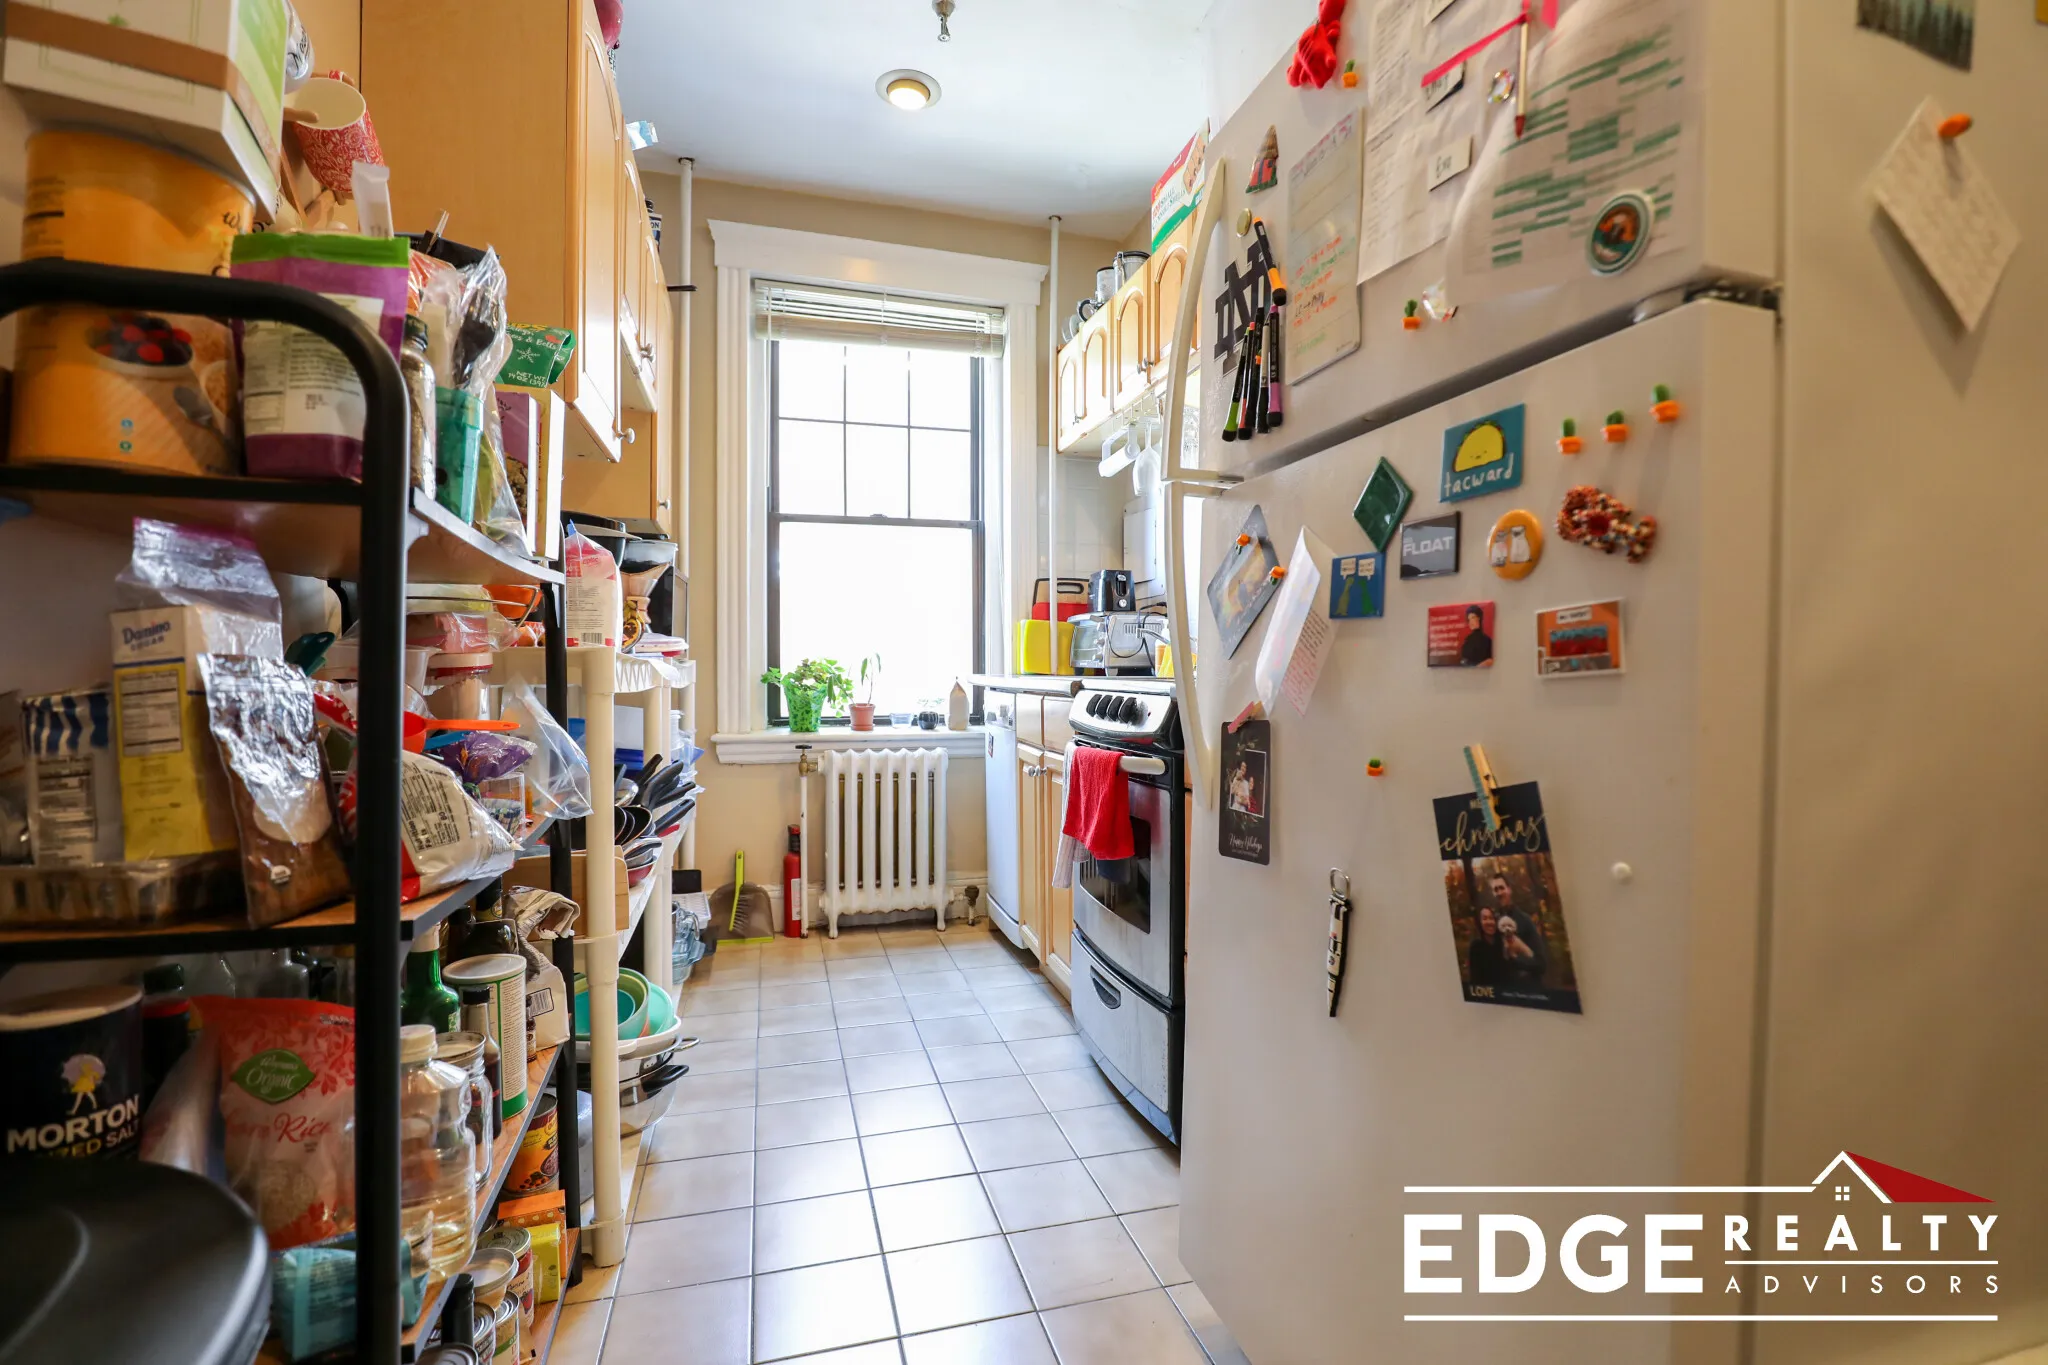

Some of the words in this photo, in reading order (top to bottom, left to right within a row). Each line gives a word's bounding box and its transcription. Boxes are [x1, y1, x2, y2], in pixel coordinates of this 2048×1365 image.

[525, 335, 533, 343] &
[536, 339, 558, 350] Bells
[516, 370, 532, 379] NET
[1443, 452, 1514, 497] tacward
[1402, 535, 1455, 557] FLOAT
[1469, 985, 1496, 999] LOVE
[7, 1093, 140, 1154] MORTON
[273, 1112, 332, 1143] Rice
